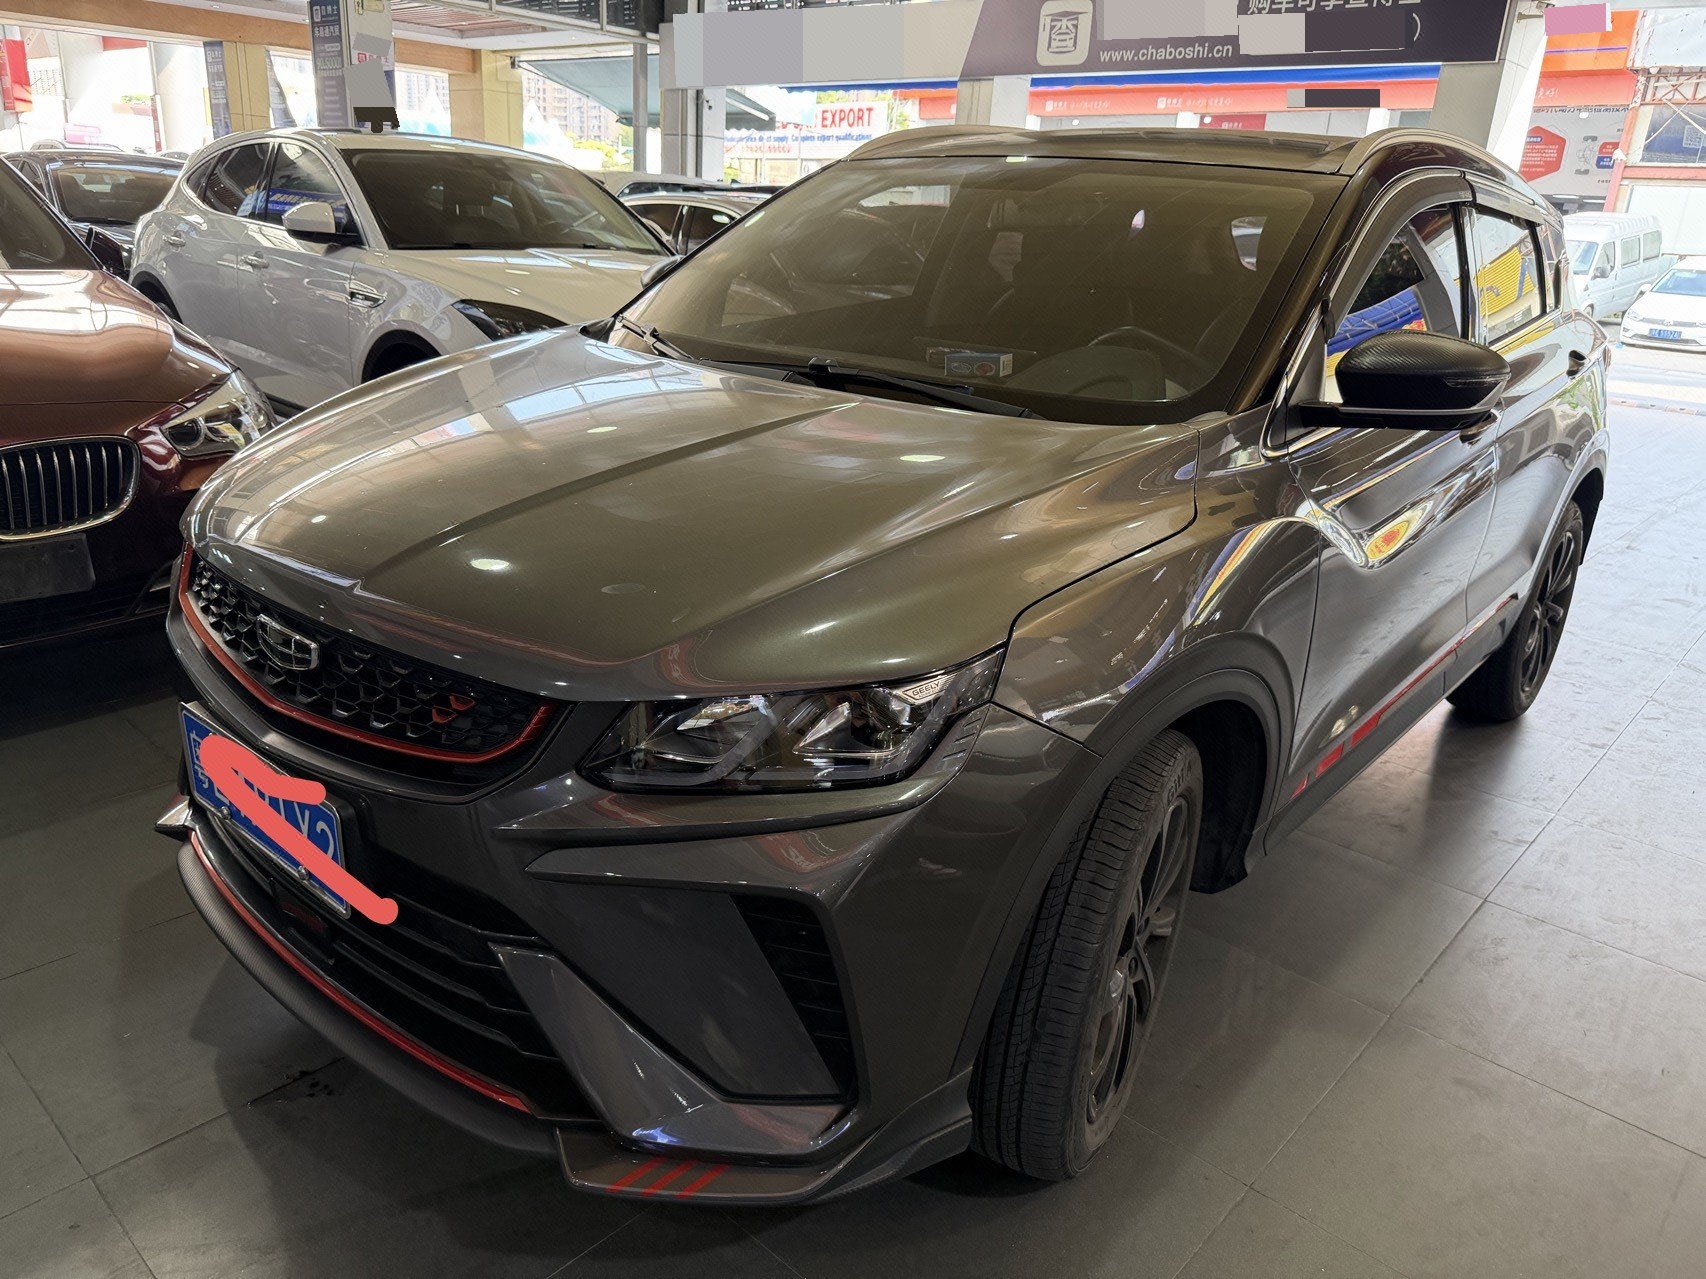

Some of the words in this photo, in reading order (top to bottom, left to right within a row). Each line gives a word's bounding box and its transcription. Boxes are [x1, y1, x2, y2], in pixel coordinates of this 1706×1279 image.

[1100, 43, 1233, 62] www.chaboshi.cn
[821, 107, 874, 128] EXPORT
[912, 681, 940, 696] GEELY
